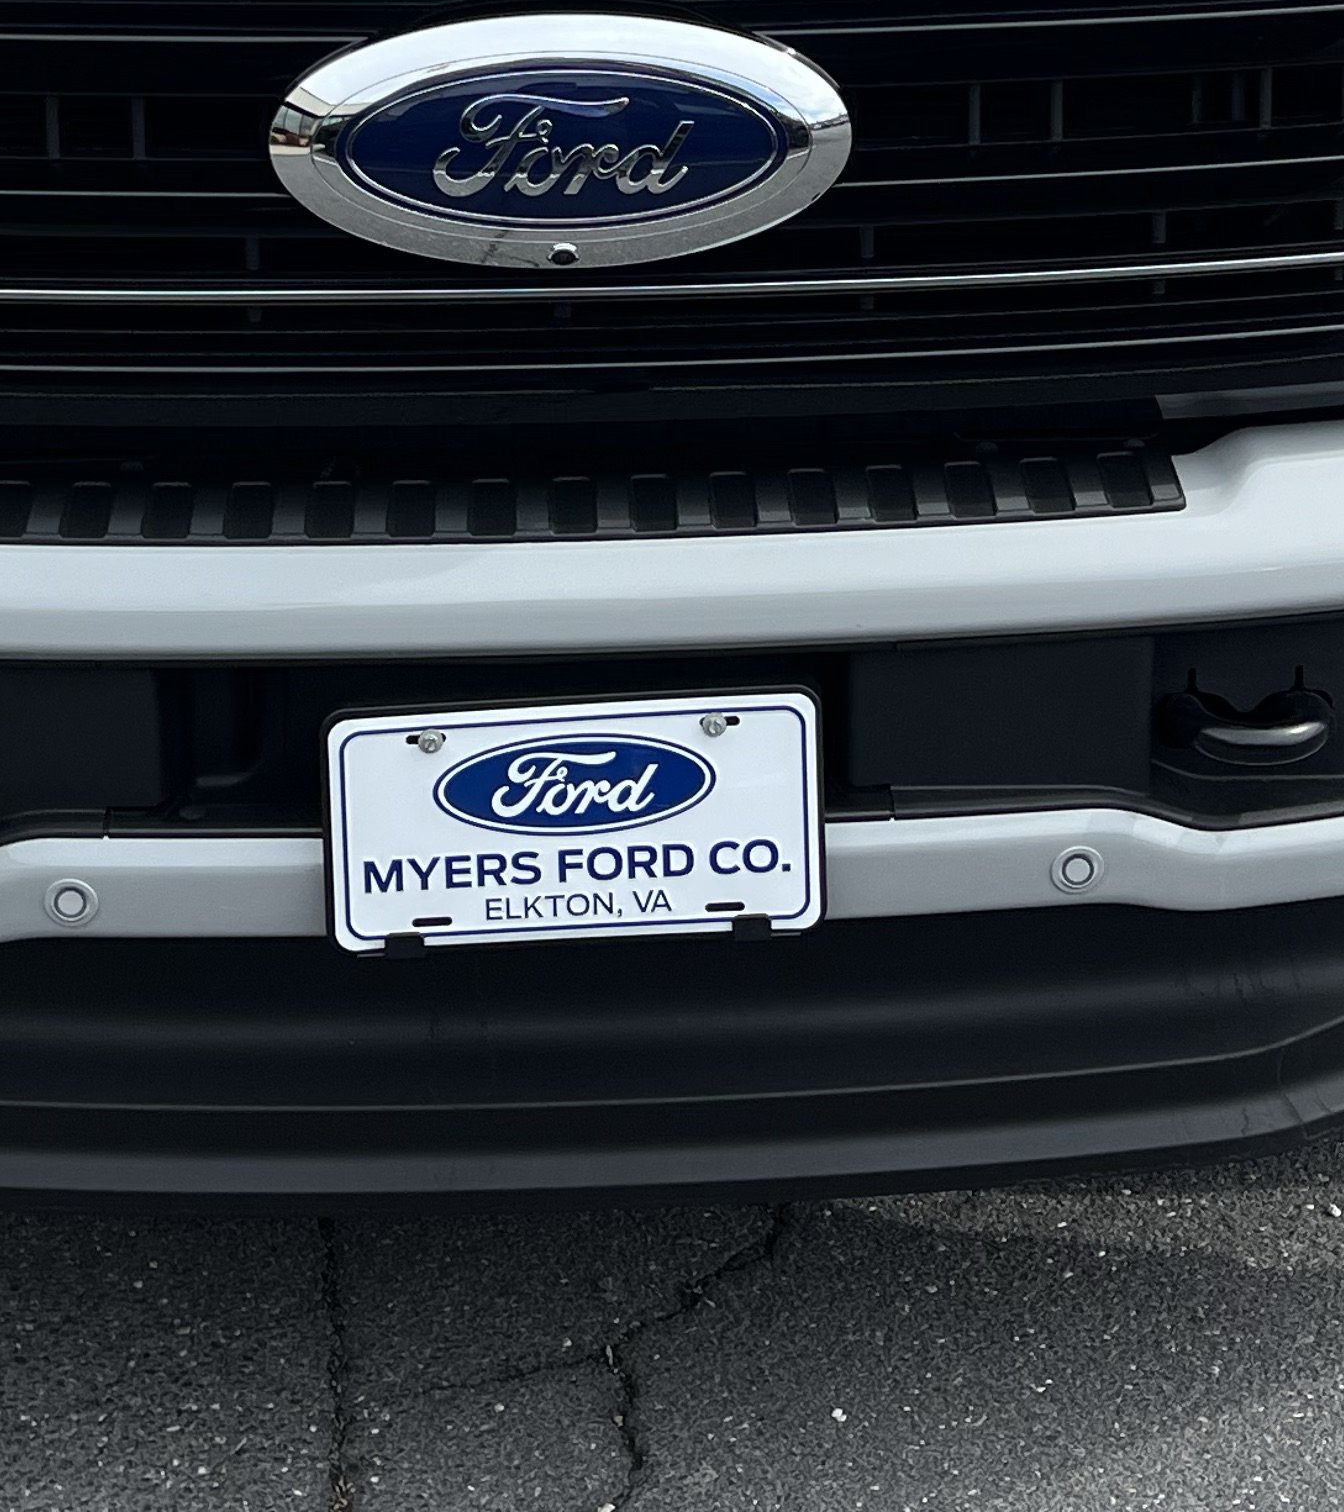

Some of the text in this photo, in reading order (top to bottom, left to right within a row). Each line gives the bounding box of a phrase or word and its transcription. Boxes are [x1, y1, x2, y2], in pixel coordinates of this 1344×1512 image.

[434, 94, 695, 196] Ford
[491, 751, 659, 817] Ford
[363, 840, 792, 894] MYERS FORD CO.
[485, 890, 672, 921] ELKTON, VA
